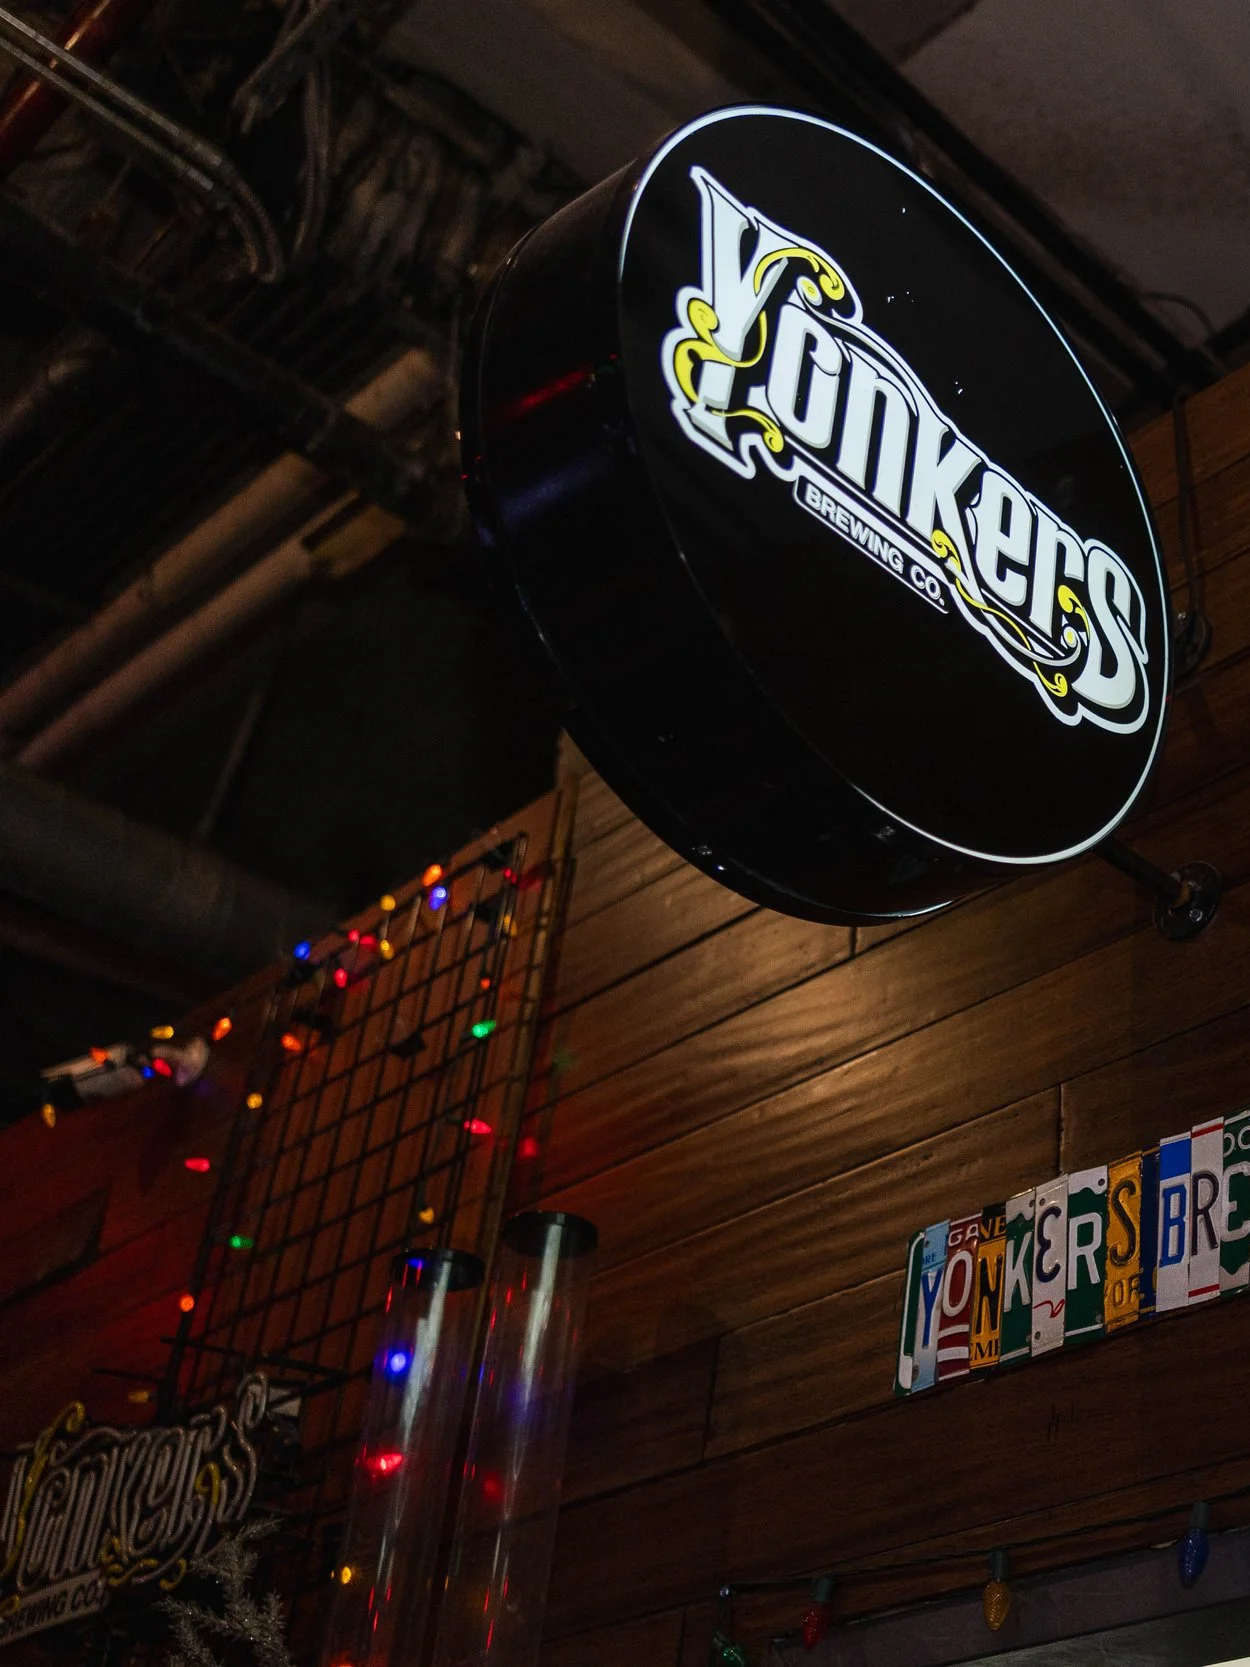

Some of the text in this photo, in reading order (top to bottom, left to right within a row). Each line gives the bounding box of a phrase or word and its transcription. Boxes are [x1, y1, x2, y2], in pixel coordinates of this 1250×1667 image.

[804, 482, 946, 607] BREWING CO.
[919, 1179, 1138, 1348] YONKERS
